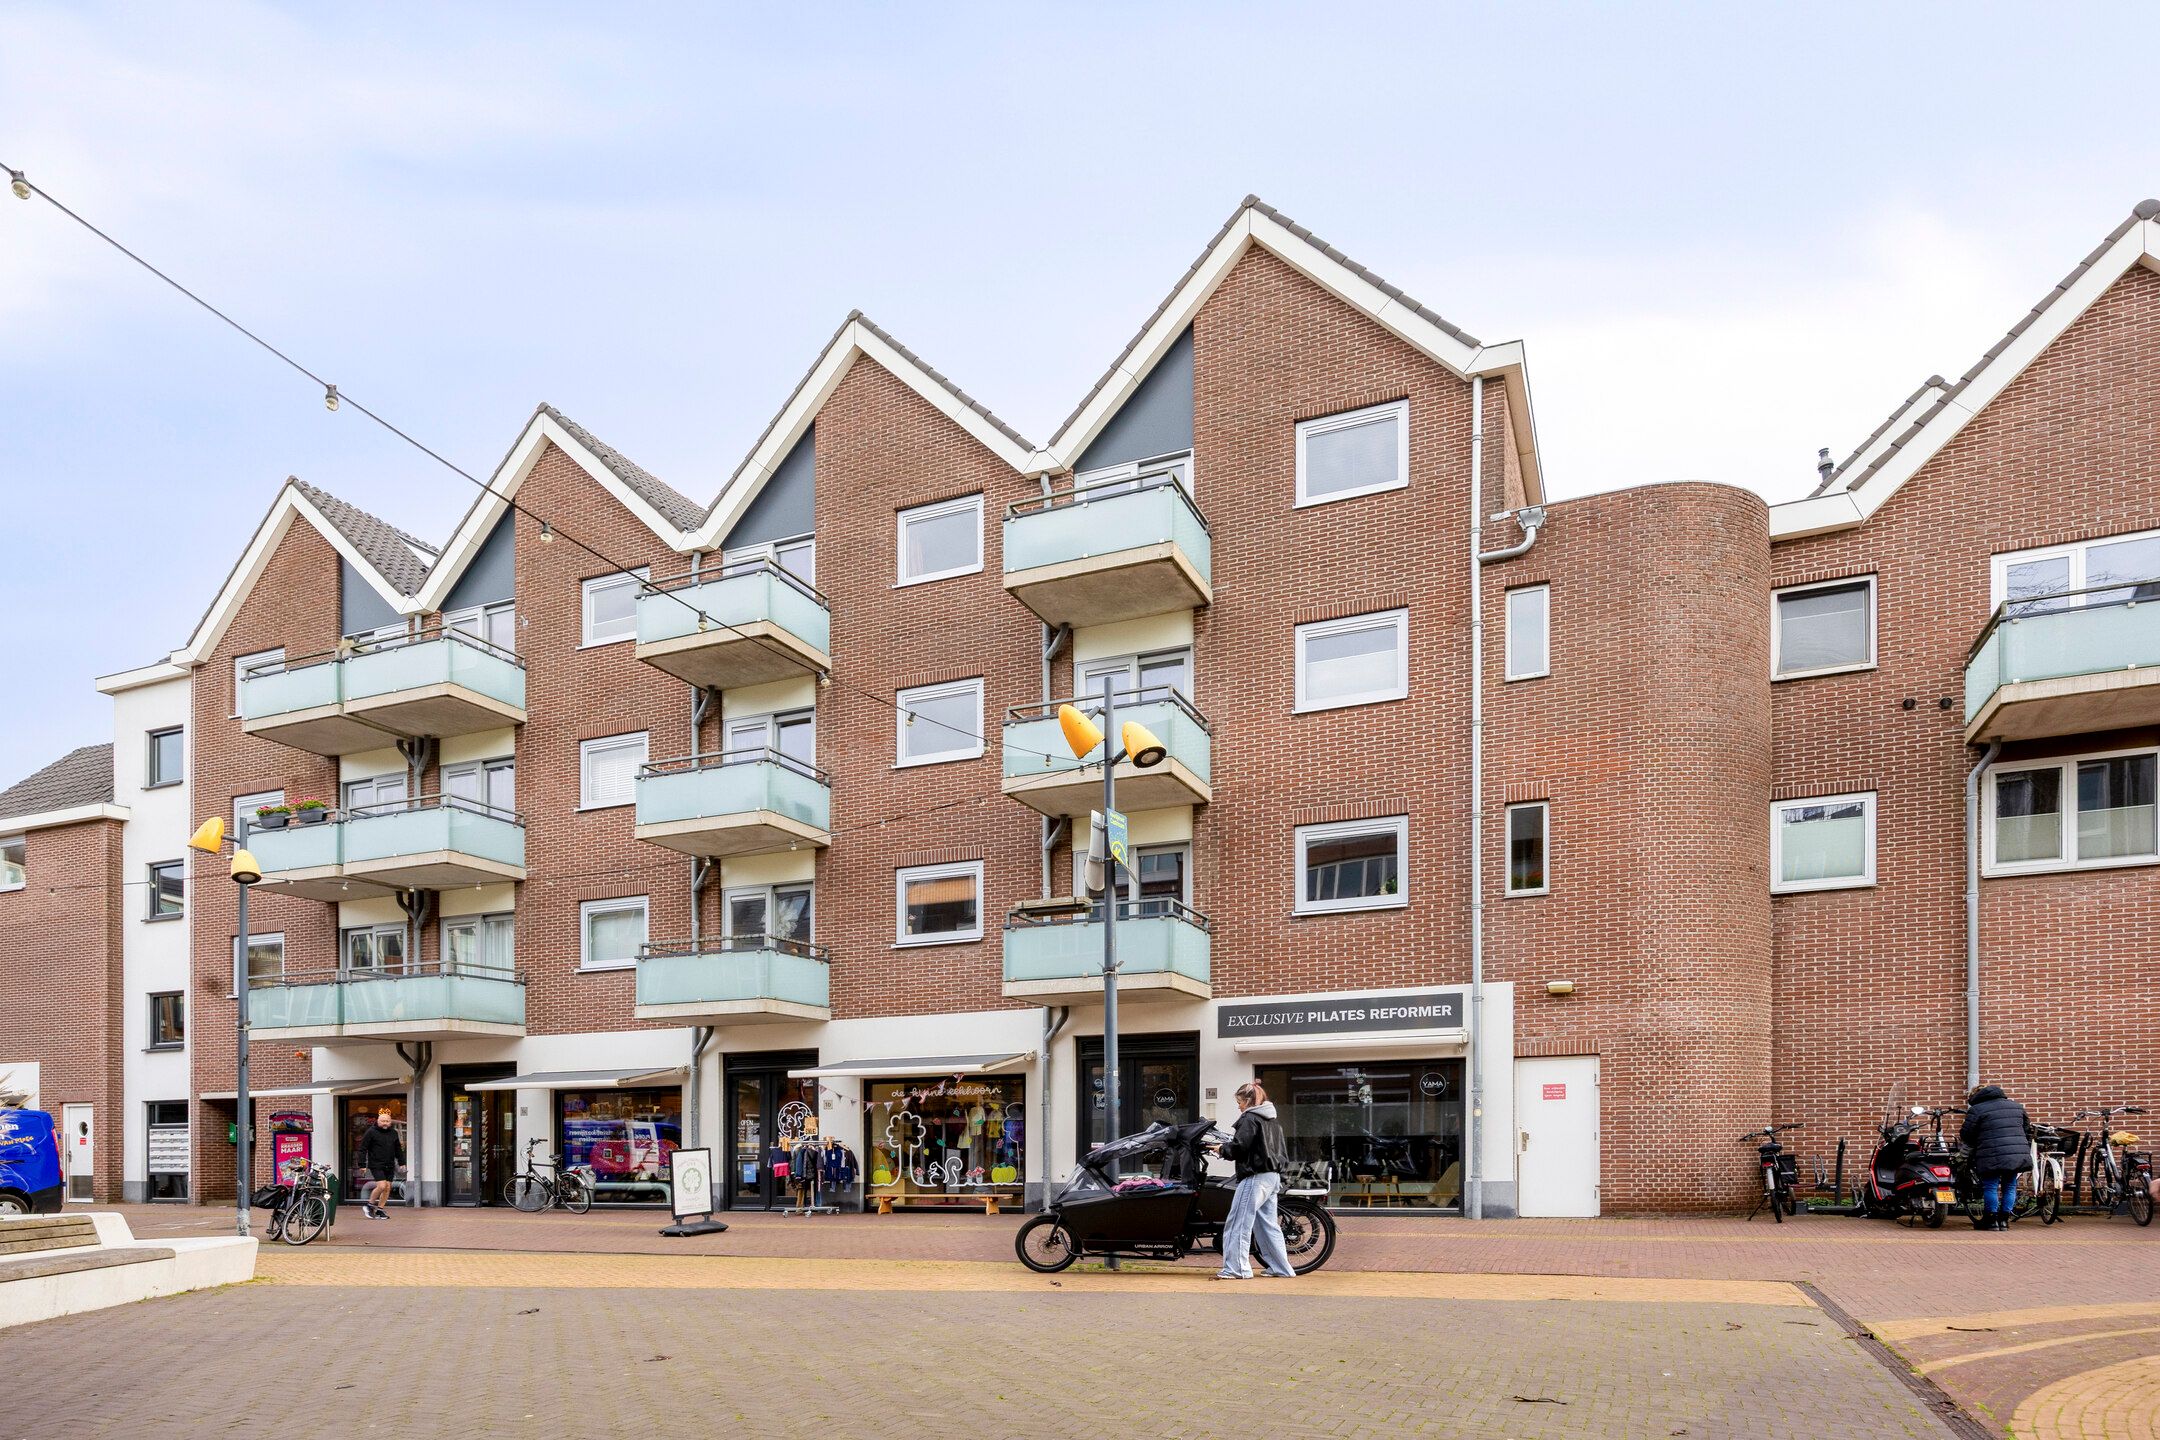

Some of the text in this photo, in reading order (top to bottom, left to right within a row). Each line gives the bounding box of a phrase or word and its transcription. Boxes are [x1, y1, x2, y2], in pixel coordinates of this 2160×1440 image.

[1227, 1005, 1452, 1027] EXCLUSIVE PILATES REFORMER
